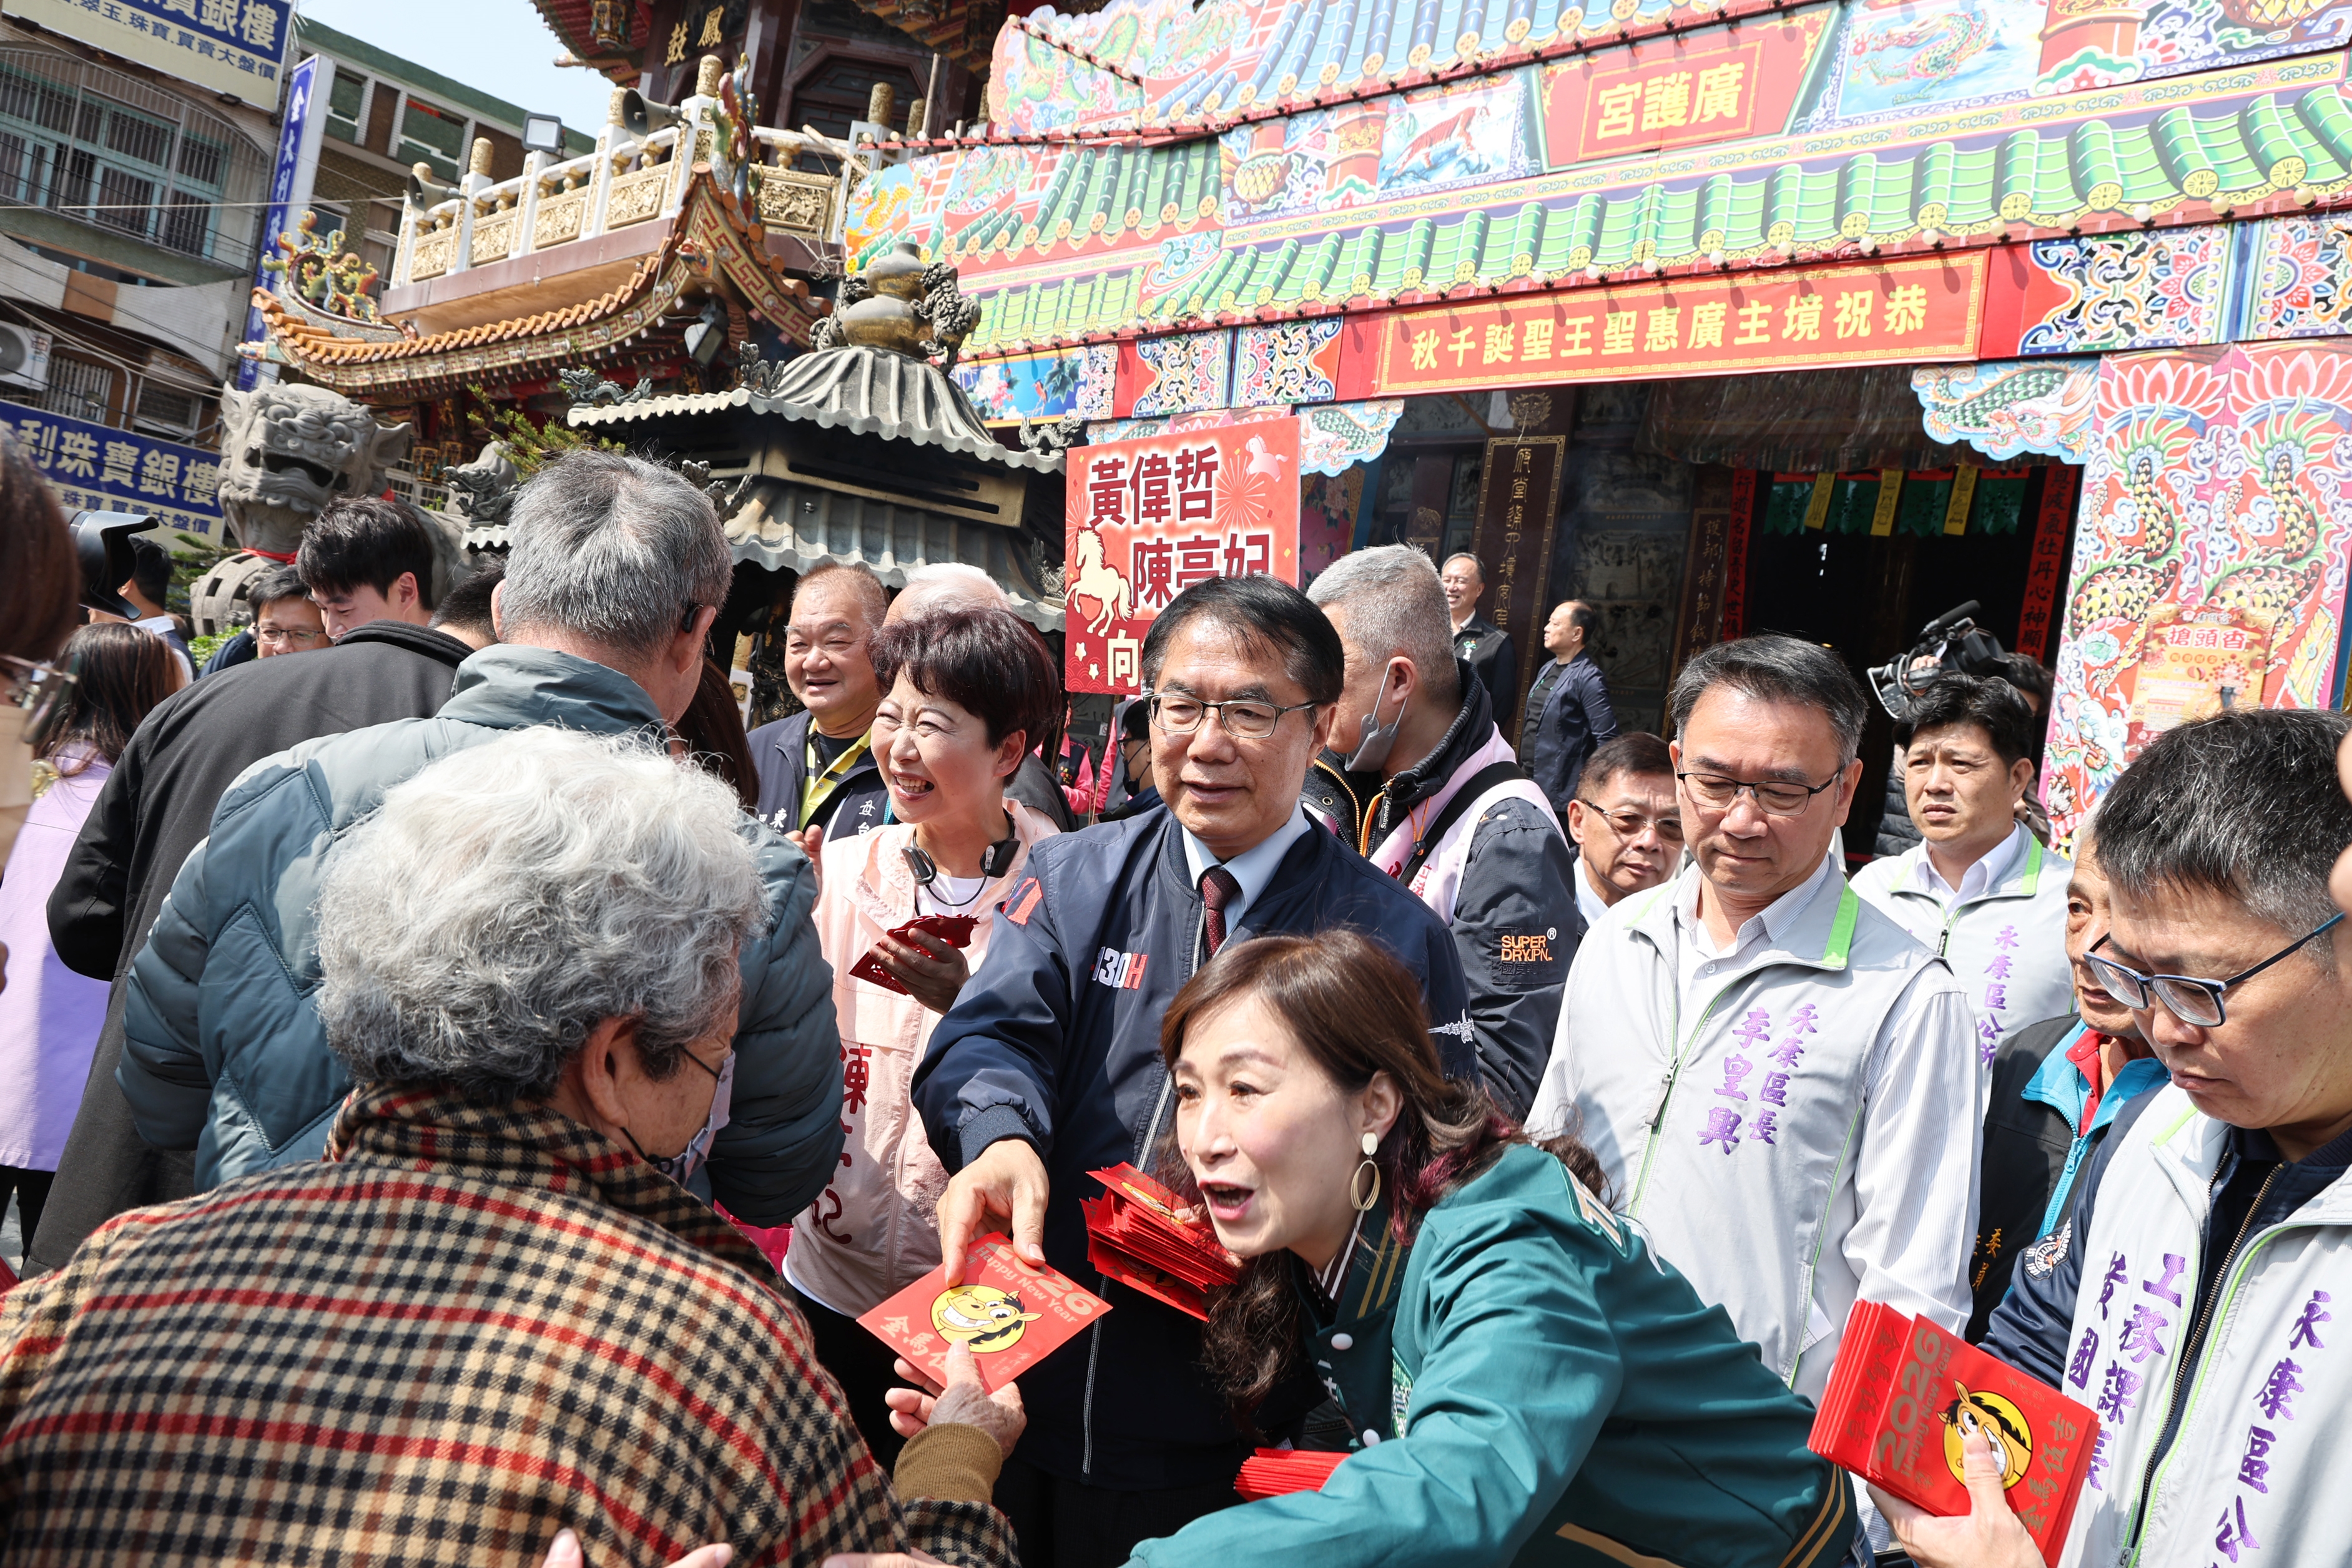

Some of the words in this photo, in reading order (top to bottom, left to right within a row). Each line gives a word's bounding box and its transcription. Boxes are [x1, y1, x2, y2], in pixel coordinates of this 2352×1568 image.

[1596, 61, 1745, 140] 廣護宮
[0, 417, 219, 507] 利珠寶銀樓
[1089, 445, 1219, 529] 黃偉哲
[1107, 629, 1139, 687] 向
[2167, 626, 2247, 650] 搶頭香
[1380, 799, 1391, 830] Superdry
[1501, 934, 1547, 949] SUPER
[1748, 1002, 1818, 1146] 永康區長
[974, 1246, 1018, 1281] Happy
[1016, 1276, 1049, 1301] New
[1047, 1297, 1078, 1323] Year
[879, 1315, 950, 1375] 金馬伍
[1877, 1327, 1941, 1471] 2026
[1901, 1422, 1930, 1479] Happy
[1920, 1384, 1941, 1419] New
[1932, 1342, 1954, 1379] Year
[2203, 1289, 2332, 1568] 永康區公
